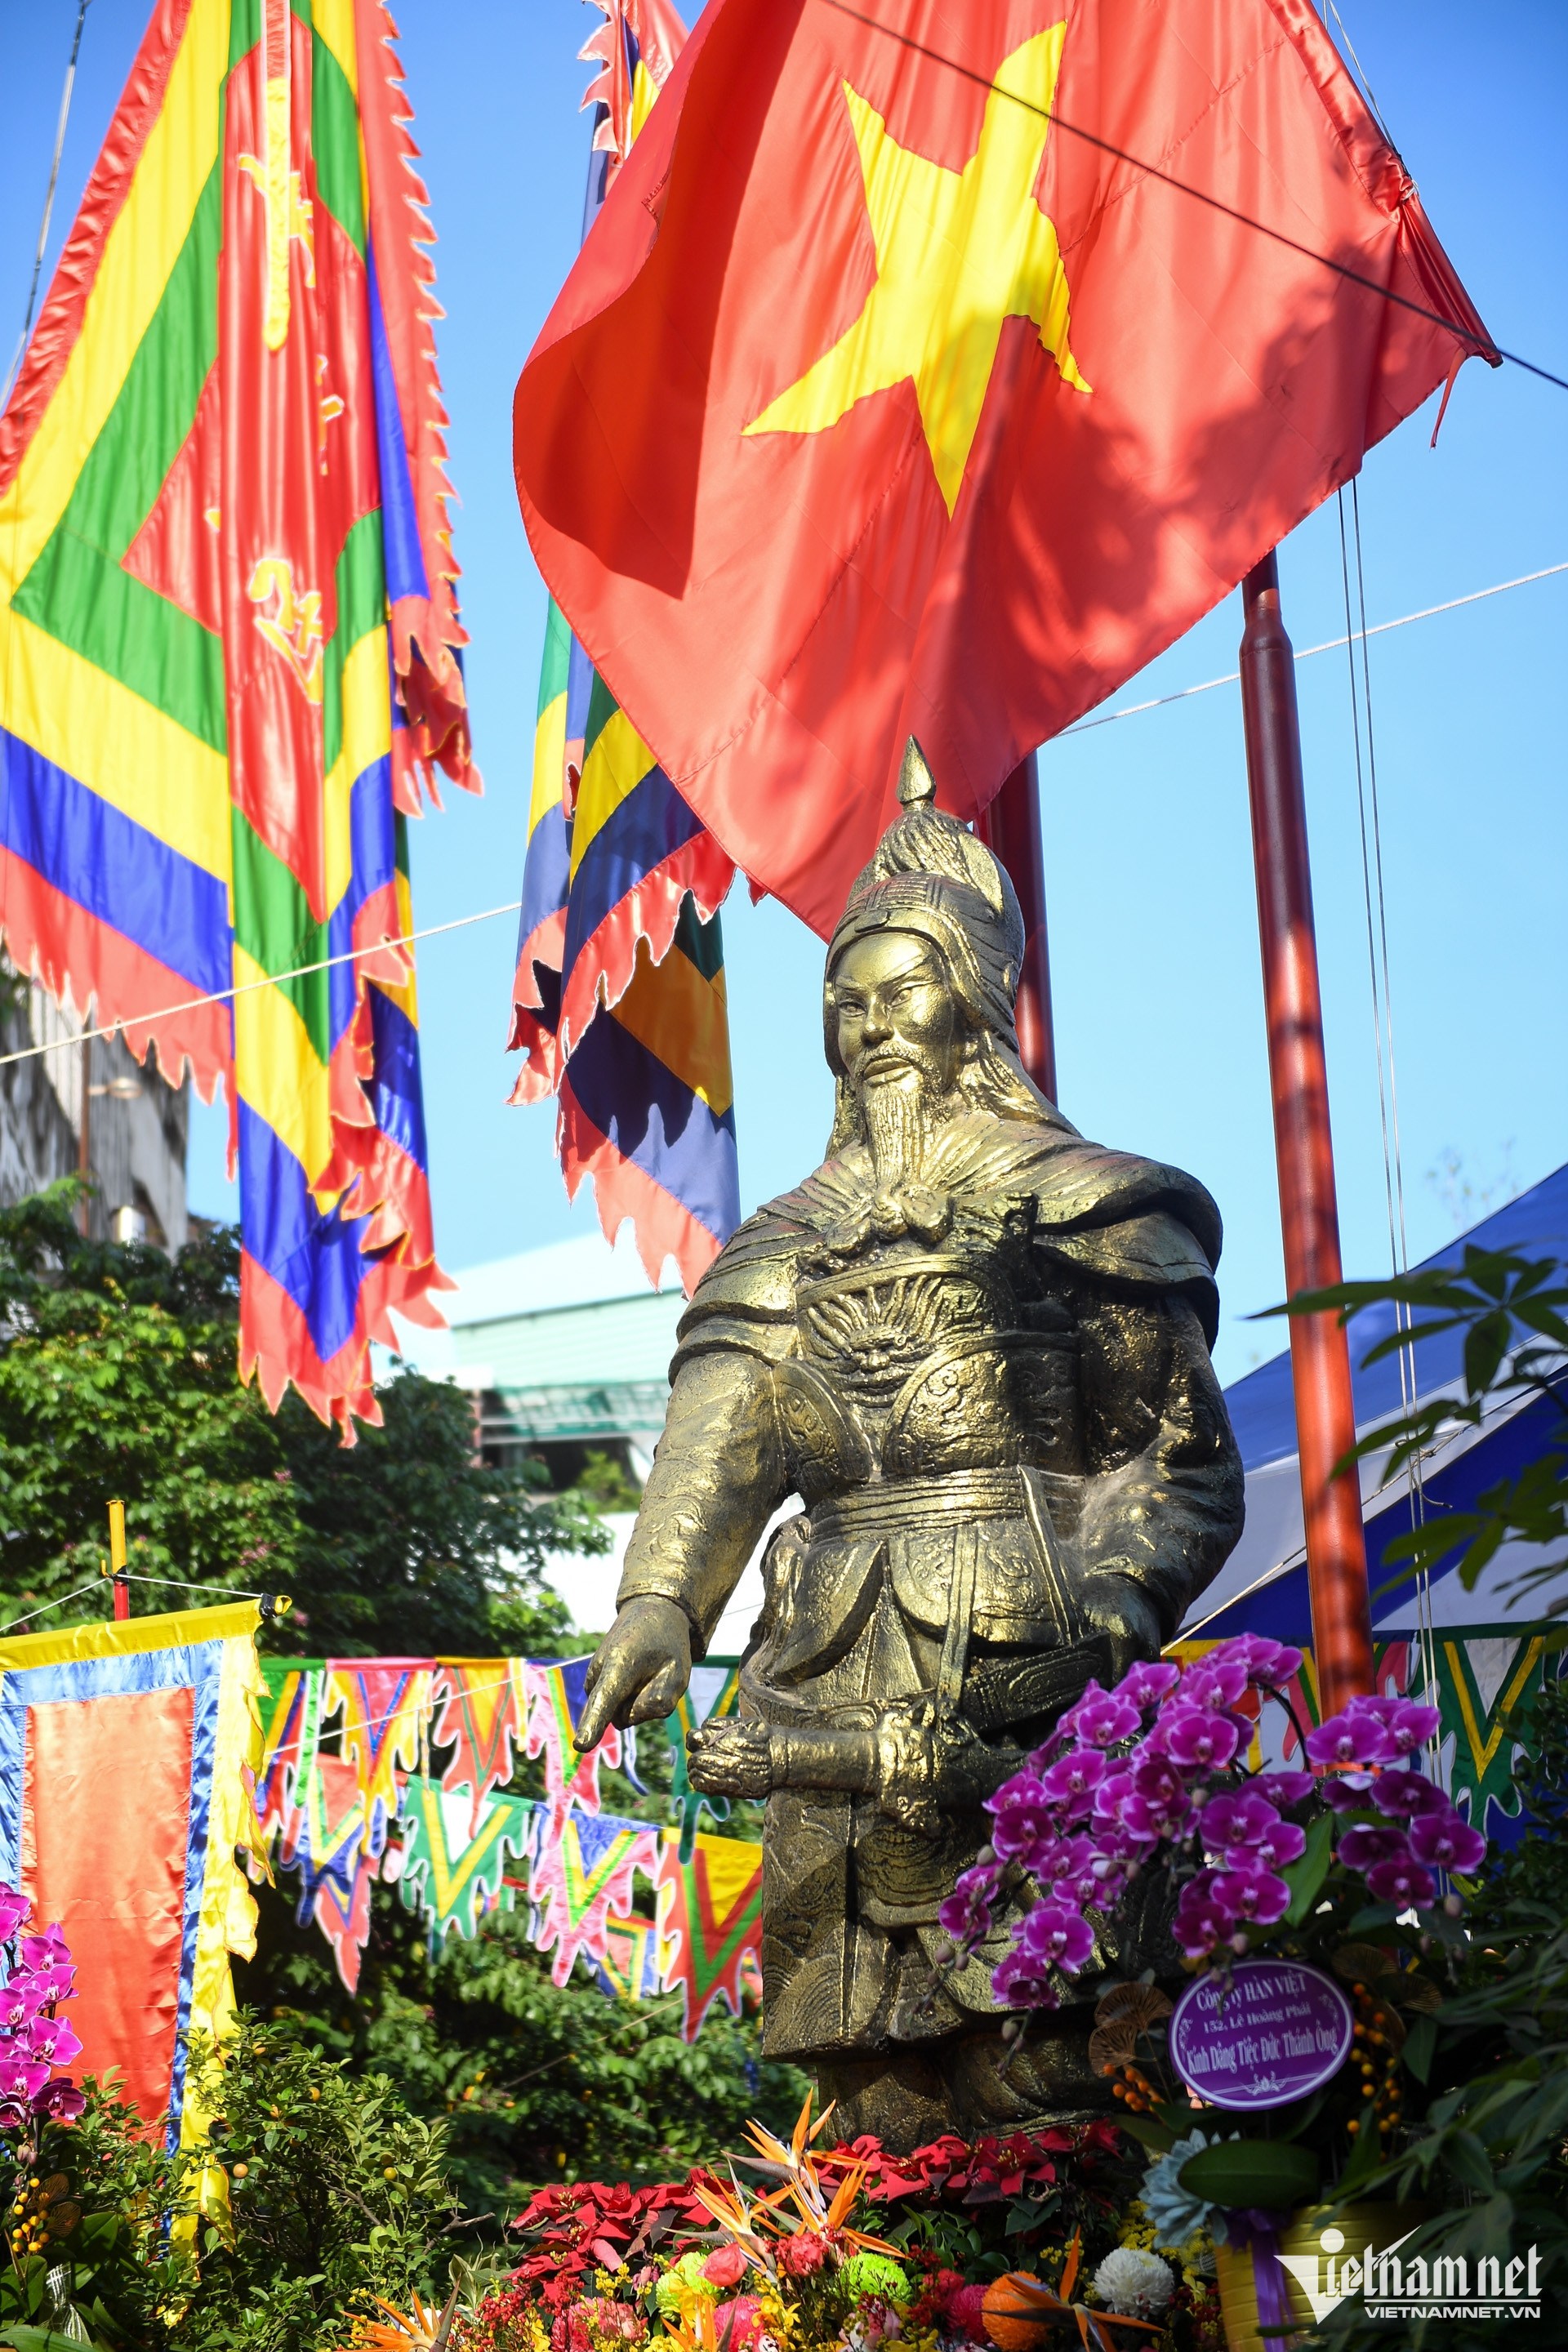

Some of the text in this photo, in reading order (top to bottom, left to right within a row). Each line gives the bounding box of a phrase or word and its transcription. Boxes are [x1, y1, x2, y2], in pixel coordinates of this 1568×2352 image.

[1244, 1974, 1275, 2002] HÀN
[1274, 1968, 1307, 1998] VIỆT
[1229, 2013, 1245, 2029] Lê
[1246, 2008, 1285, 2025] Hoàng
[1186, 2045, 1210, 2075] Kính
[1209, 2041, 1237, 2074] Dâng
[1281, 2025, 1316, 2059] Thánh
[1315, 2018, 1339, 2056] Ông
